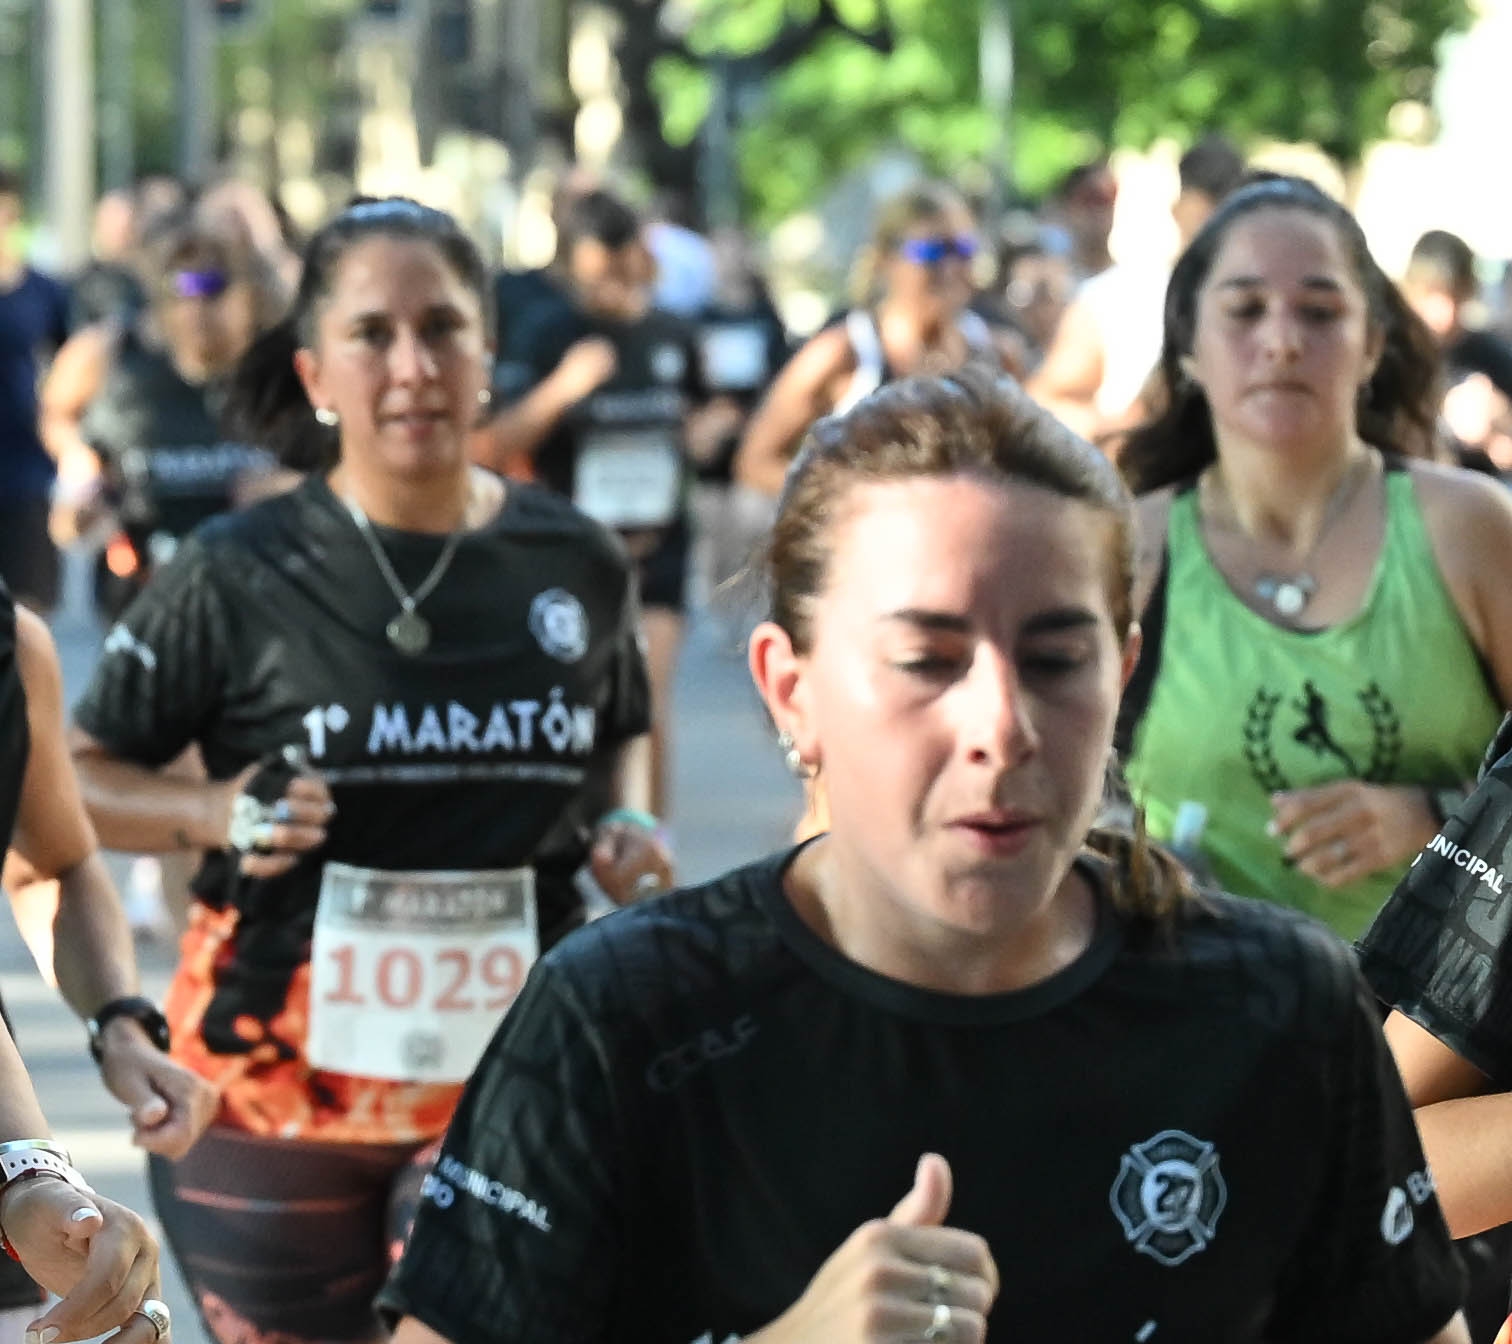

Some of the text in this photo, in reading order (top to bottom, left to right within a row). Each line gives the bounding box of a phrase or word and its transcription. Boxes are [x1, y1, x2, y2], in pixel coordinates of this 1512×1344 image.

[367, 685, 596, 755] MARATÓN
[1425, 833, 1504, 895] UNICIPAL
[323, 943, 525, 1013] 1029
[1155, 1172, 1195, 1213] 27
